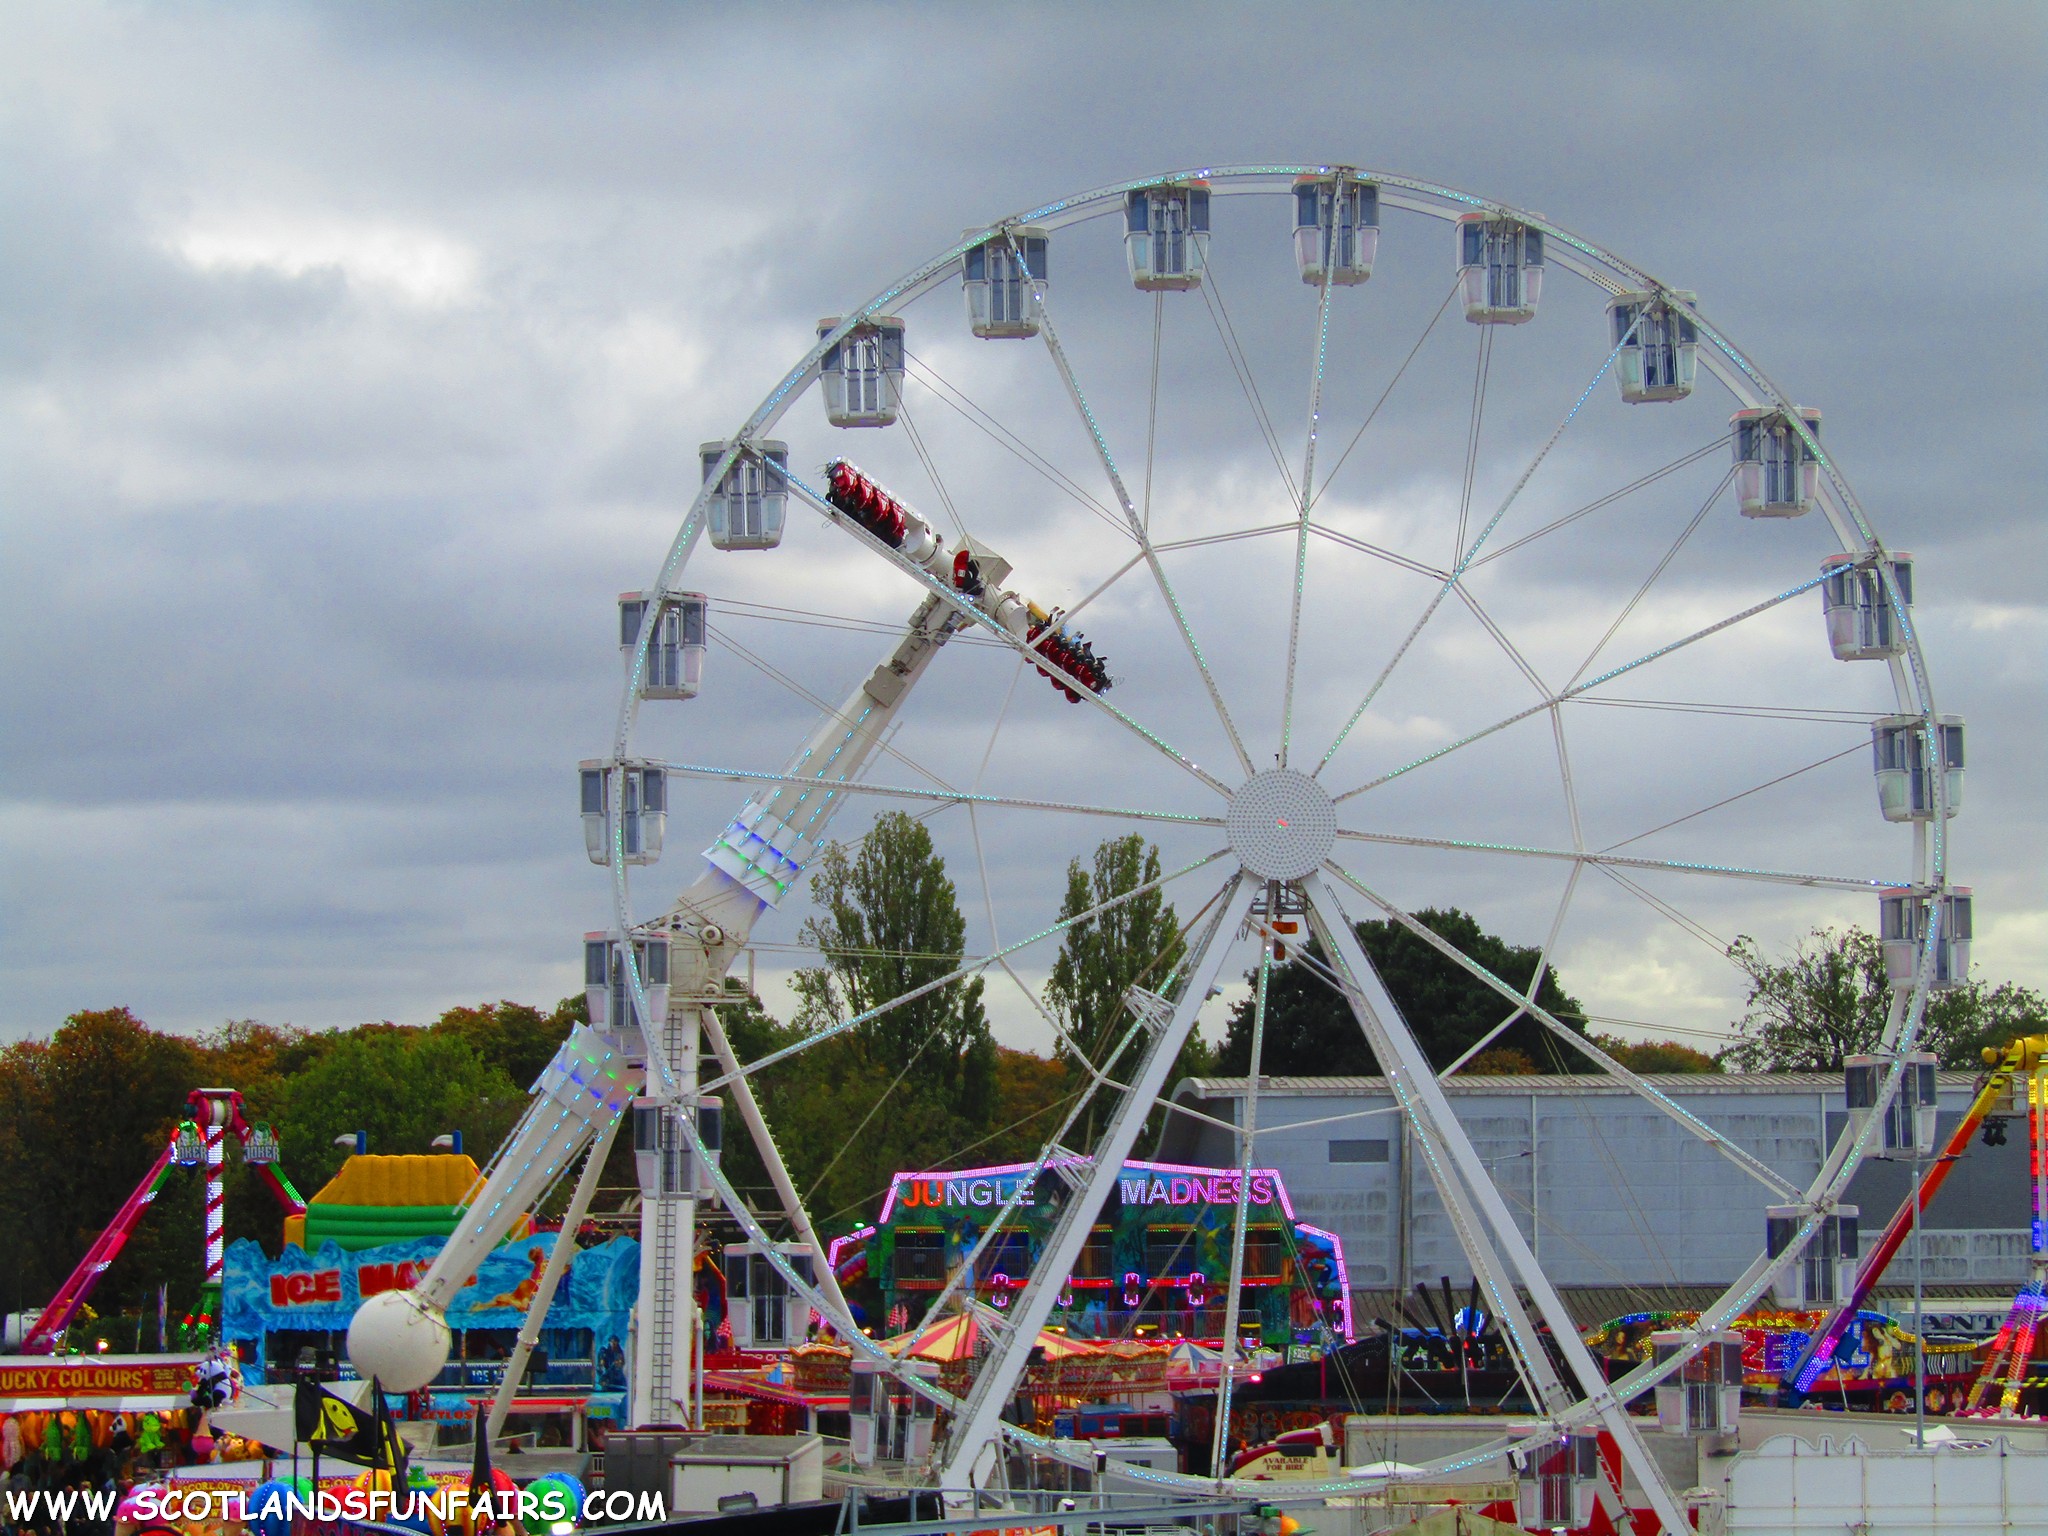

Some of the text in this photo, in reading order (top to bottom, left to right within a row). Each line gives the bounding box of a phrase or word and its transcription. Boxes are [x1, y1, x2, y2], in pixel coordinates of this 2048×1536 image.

[244, 1146, 279, 1160] JOKER
[903, 1177, 1273, 1207] JUNGLE MADNESS
[270, 1269, 341, 1306] ICE
[0, 1369, 52, 1391] UCKY
[58, 1369, 144, 1389] COLOURS
